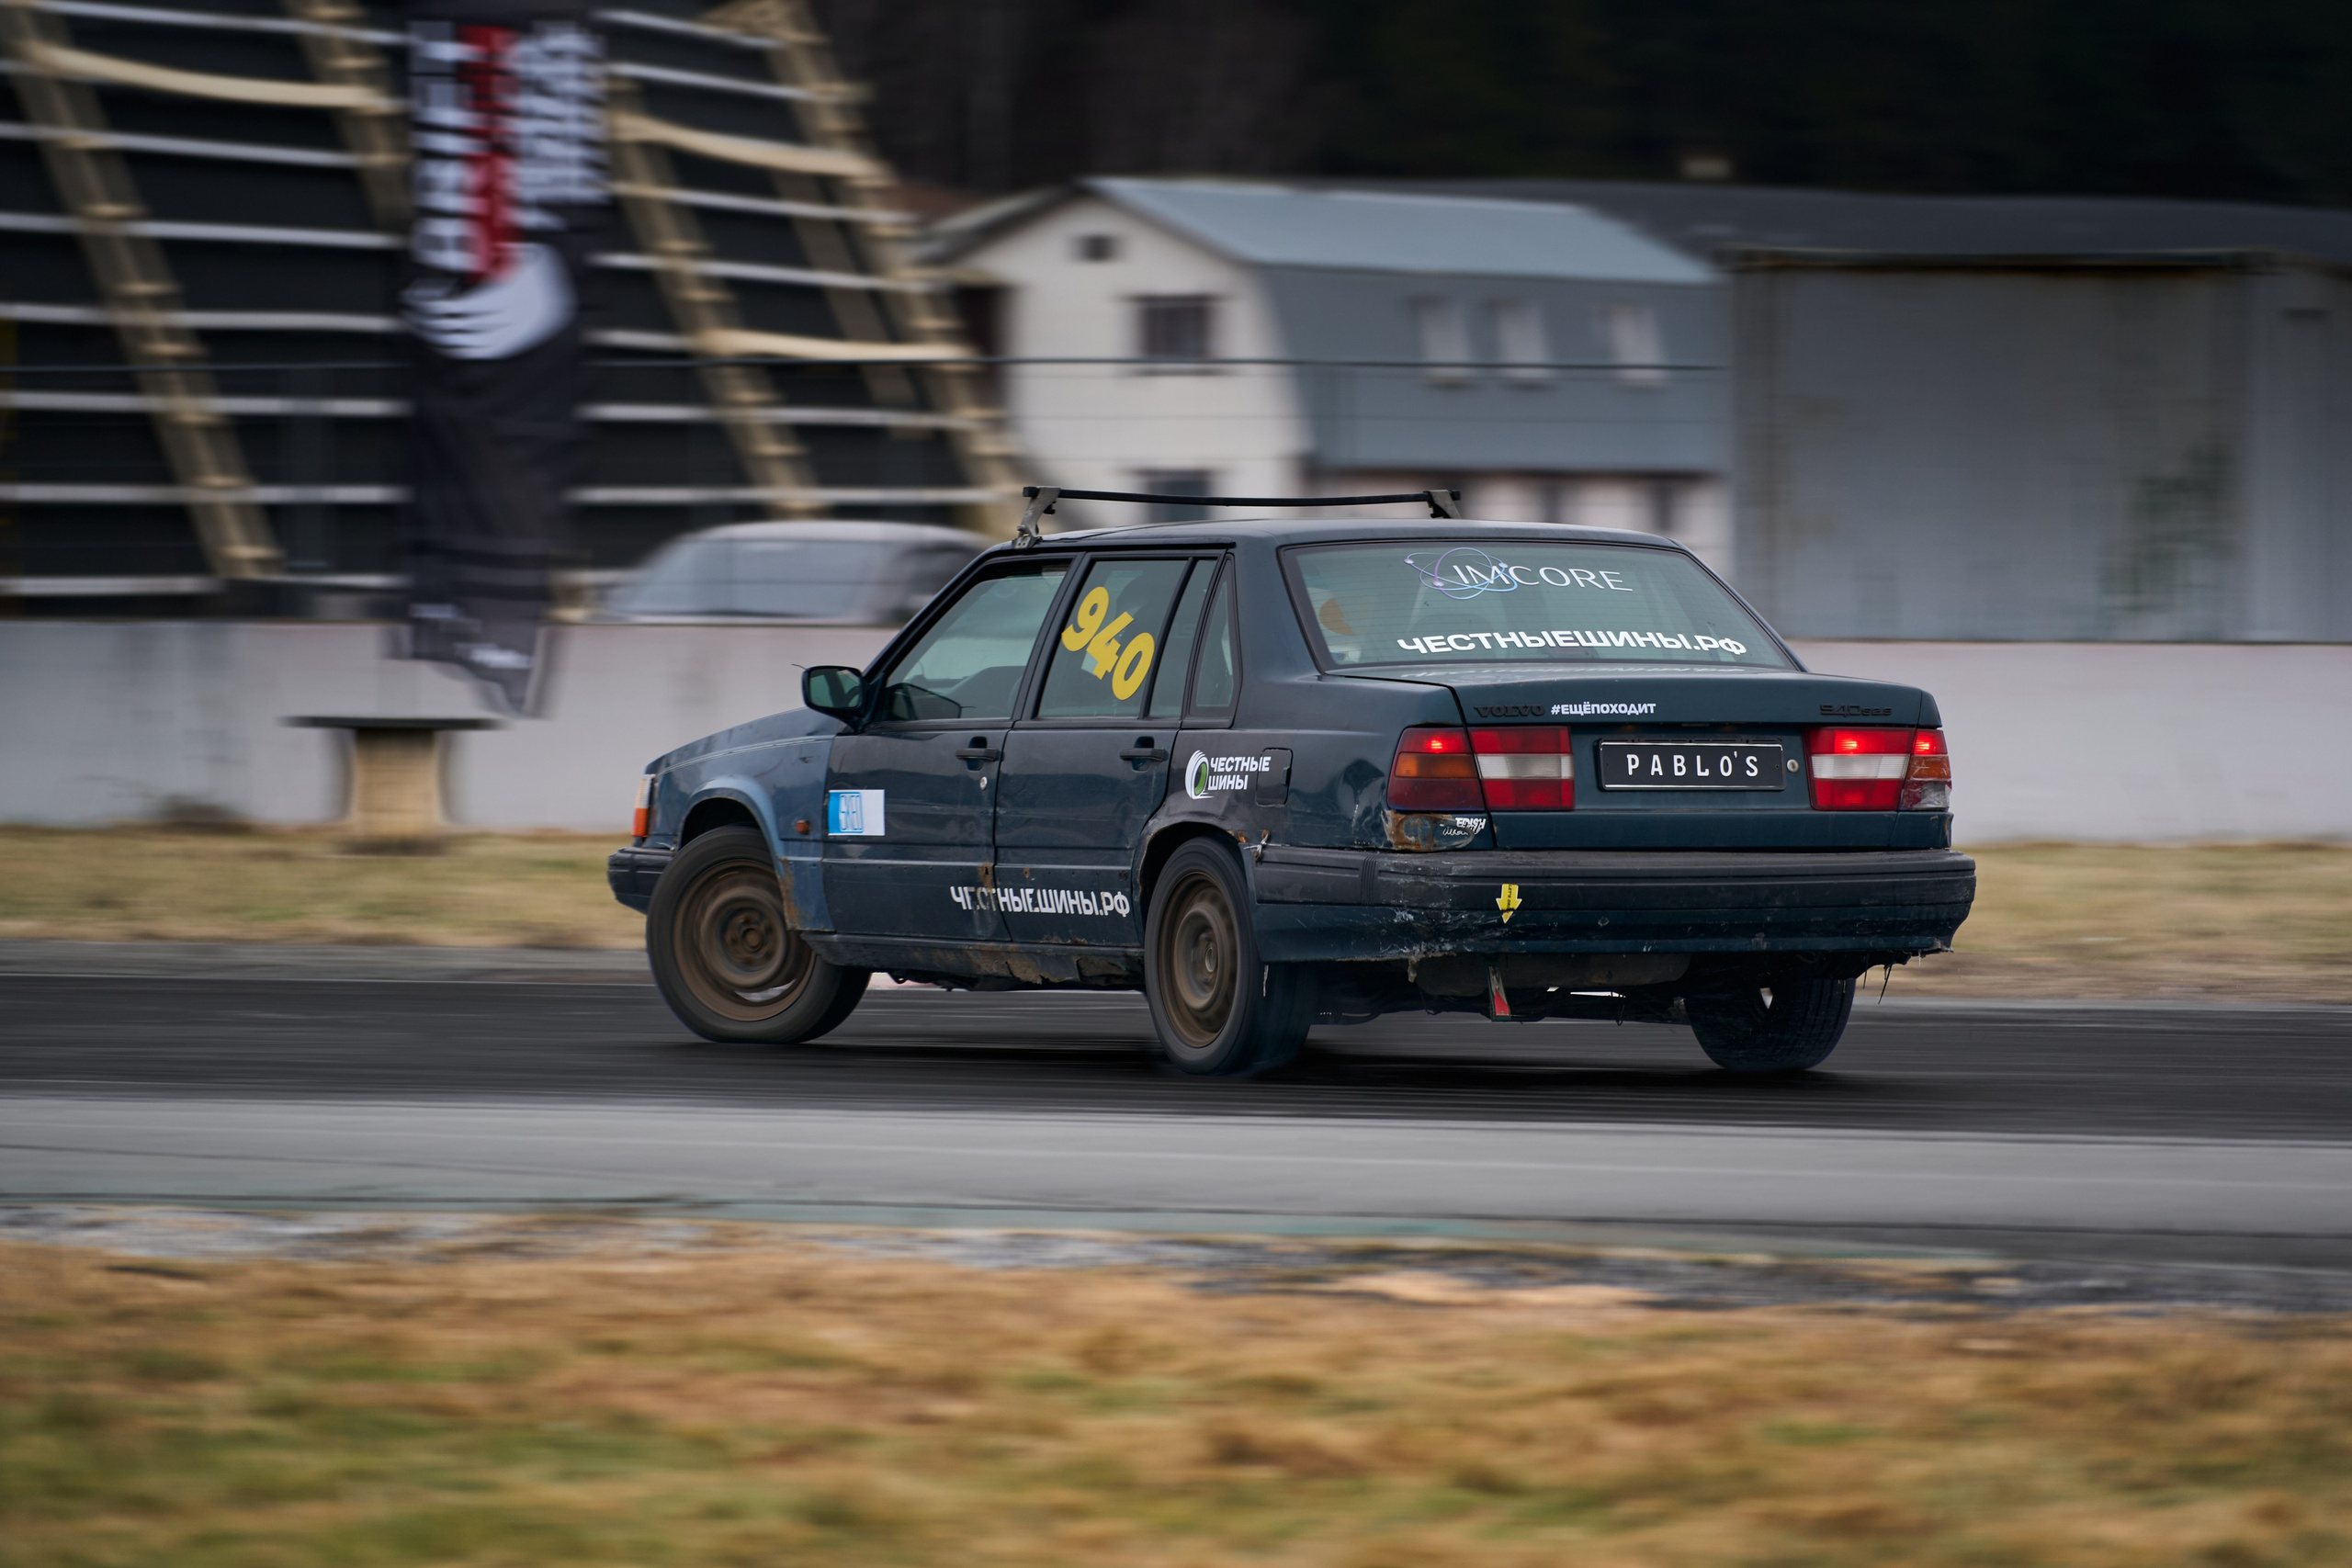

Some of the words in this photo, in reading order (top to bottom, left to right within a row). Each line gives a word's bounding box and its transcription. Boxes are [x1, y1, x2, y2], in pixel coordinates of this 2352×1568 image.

[1452, 564, 1634, 592] IMCORE
[1061, 586, 1155, 701] 940
[1396, 630, 1747, 656] ЧЕСТНЫЕШИНЫ.РФ
[1474, 704, 1546, 718] VOLVO
[1550, 701, 1657, 716] #ЕЩЁПОХОДИТ
[1210, 756, 1272, 773] ЧЕСТНЫЕ
[1626, 750, 1759, 777] PABLO'S
[1207, 774, 1249, 791] ШИНЫ
